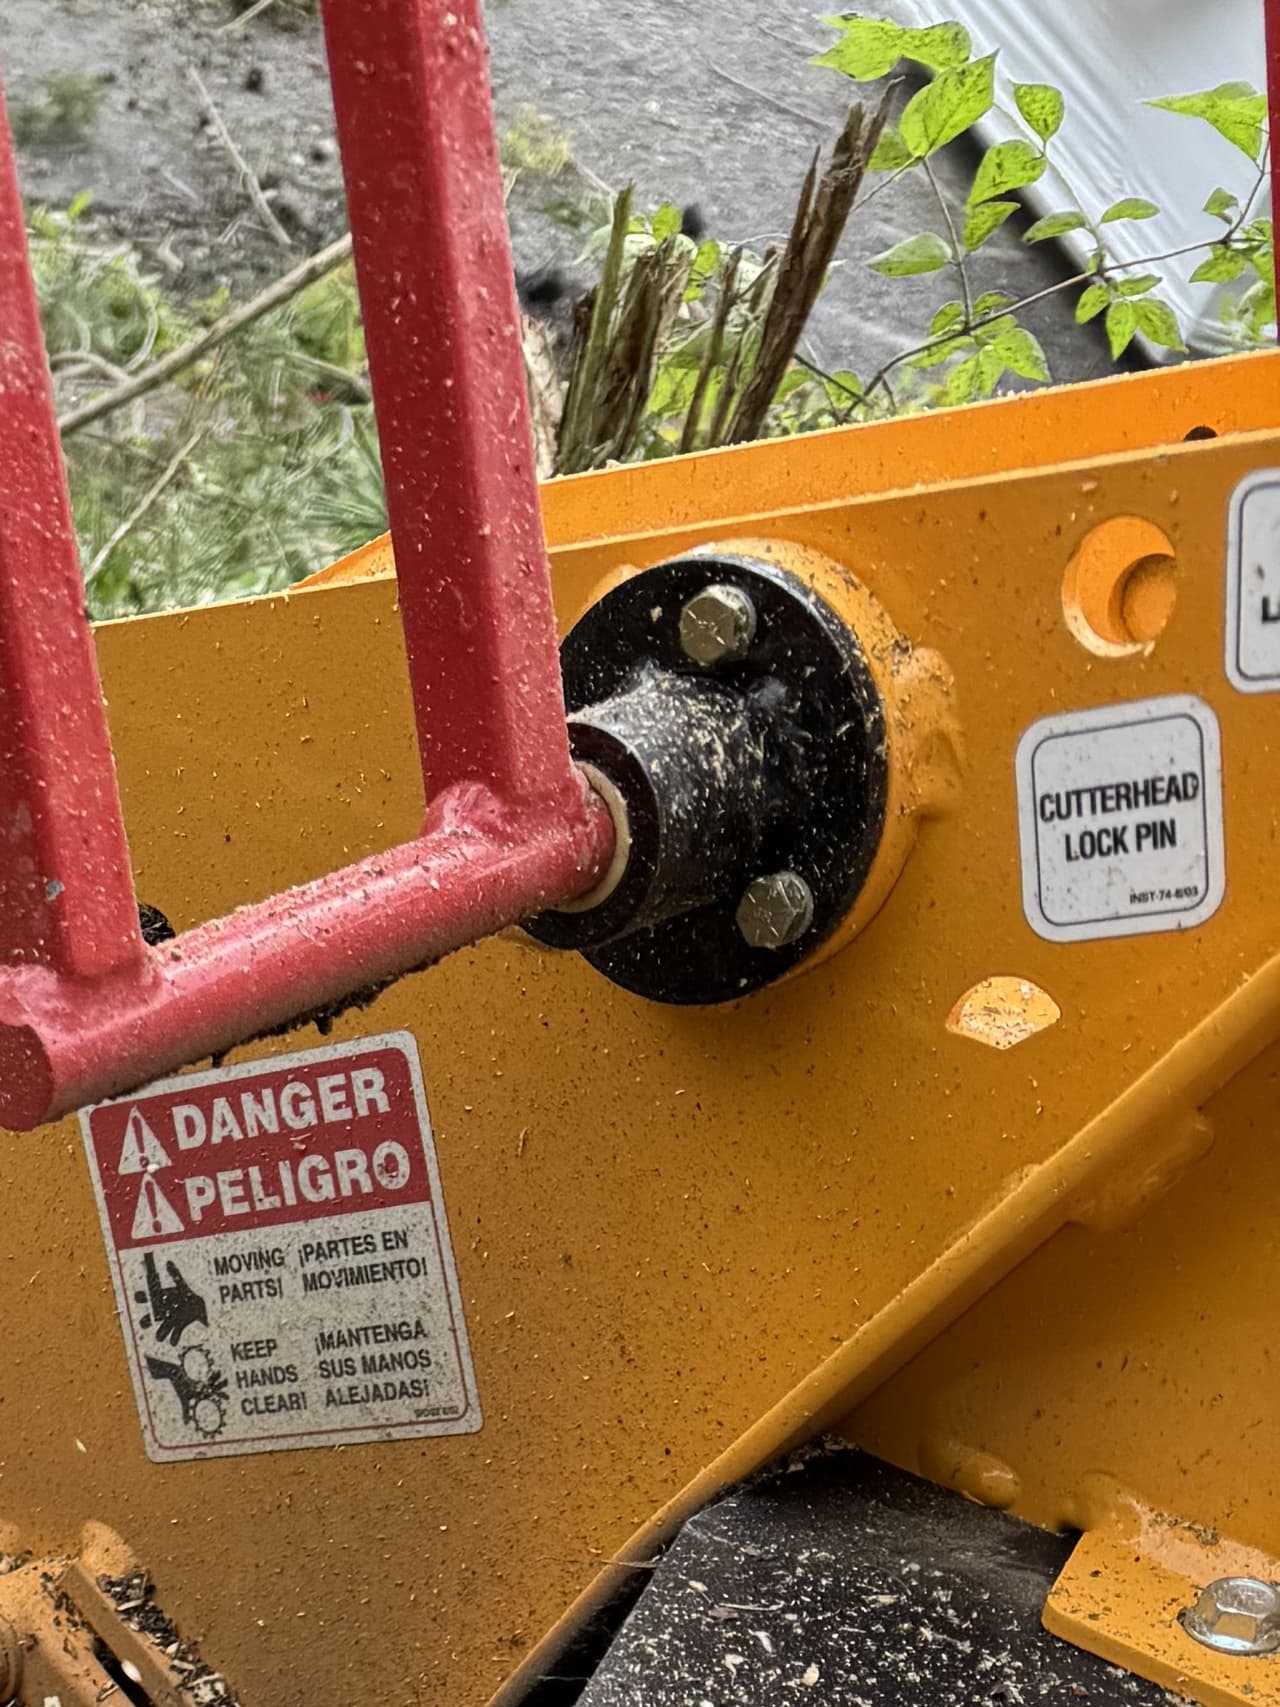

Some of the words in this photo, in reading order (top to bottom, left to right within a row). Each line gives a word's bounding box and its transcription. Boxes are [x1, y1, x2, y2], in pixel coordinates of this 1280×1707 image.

[1040, 772, 1199, 822] CUTTERHEAD
[1065, 825, 1129, 862] LOCK
[1136, 818, 1176, 852] PIN
[172, 1067, 390, 1151] DANGER
[185, 1141, 410, 1221] PELIGRO
[214, 1249, 285, 1276] MOVING
[299, 1234, 376, 1267] ¡PARTES
[382, 1231, 409, 1250] EN
[219, 1277, 283, 1304] PARTS!
[302, 1257, 428, 1293] MOVIMIENTO!
[231, 1339, 277, 1361] KEEP
[315, 1320, 428, 1355] ¡MANTENGA
[236, 1364, 298, 1388] HANDS
[319, 1358, 357, 1379] SUS
[362, 1349, 431, 1375] MANOS
[241, 1392, 308, 1416] CLEAR!
